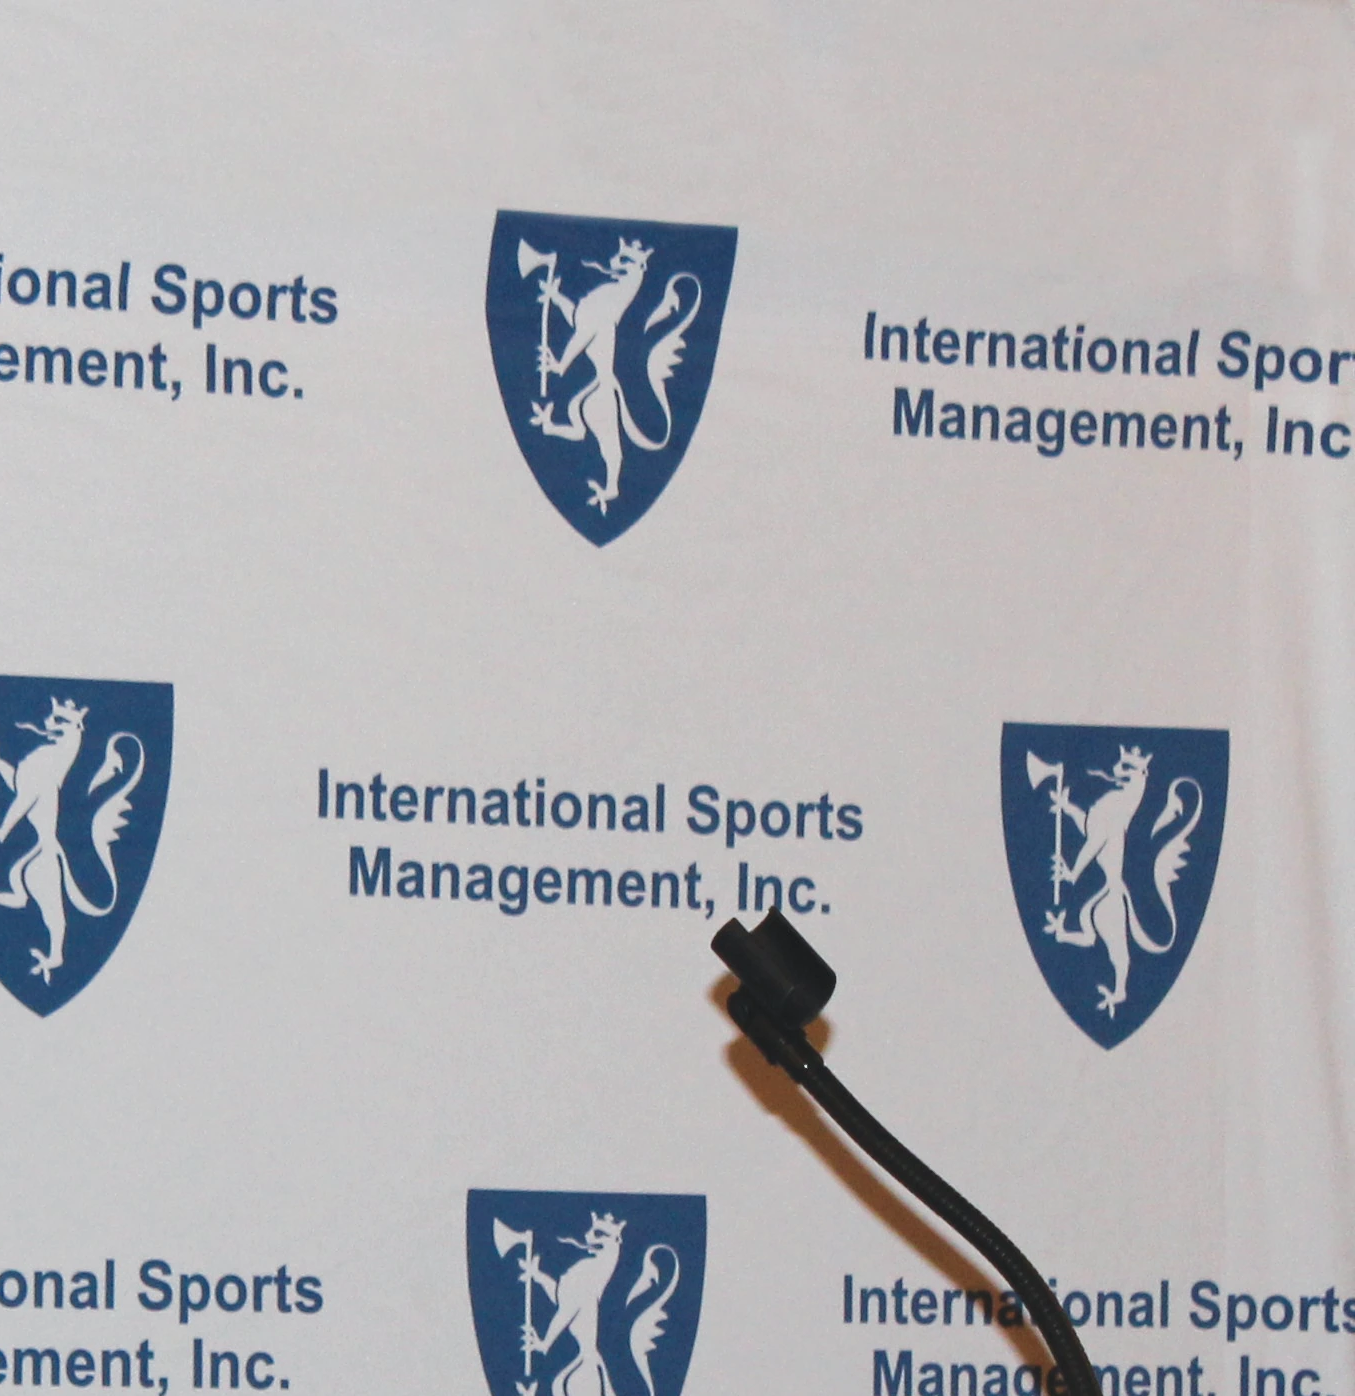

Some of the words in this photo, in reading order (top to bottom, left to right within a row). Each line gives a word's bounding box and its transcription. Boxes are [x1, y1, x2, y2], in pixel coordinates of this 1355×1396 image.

[152, 263, 338, 330] Sports
[206, 343, 303, 399] Inc.
[865, 311, 1201, 377] International
[1216, 329, 1355, 392] Spor
[893, 387, 1244, 459] Management,
[318, 767, 666, 833] International
[687, 784, 864, 849] Sports
[349, 845, 715, 918] Management,
[737, 861, 832, 914] Inc.
[138, 1258, 324, 1325] Sports
[843, 1273, 1171, 1328] Internaonal
[193, 1337, 290, 1391] Inc.
